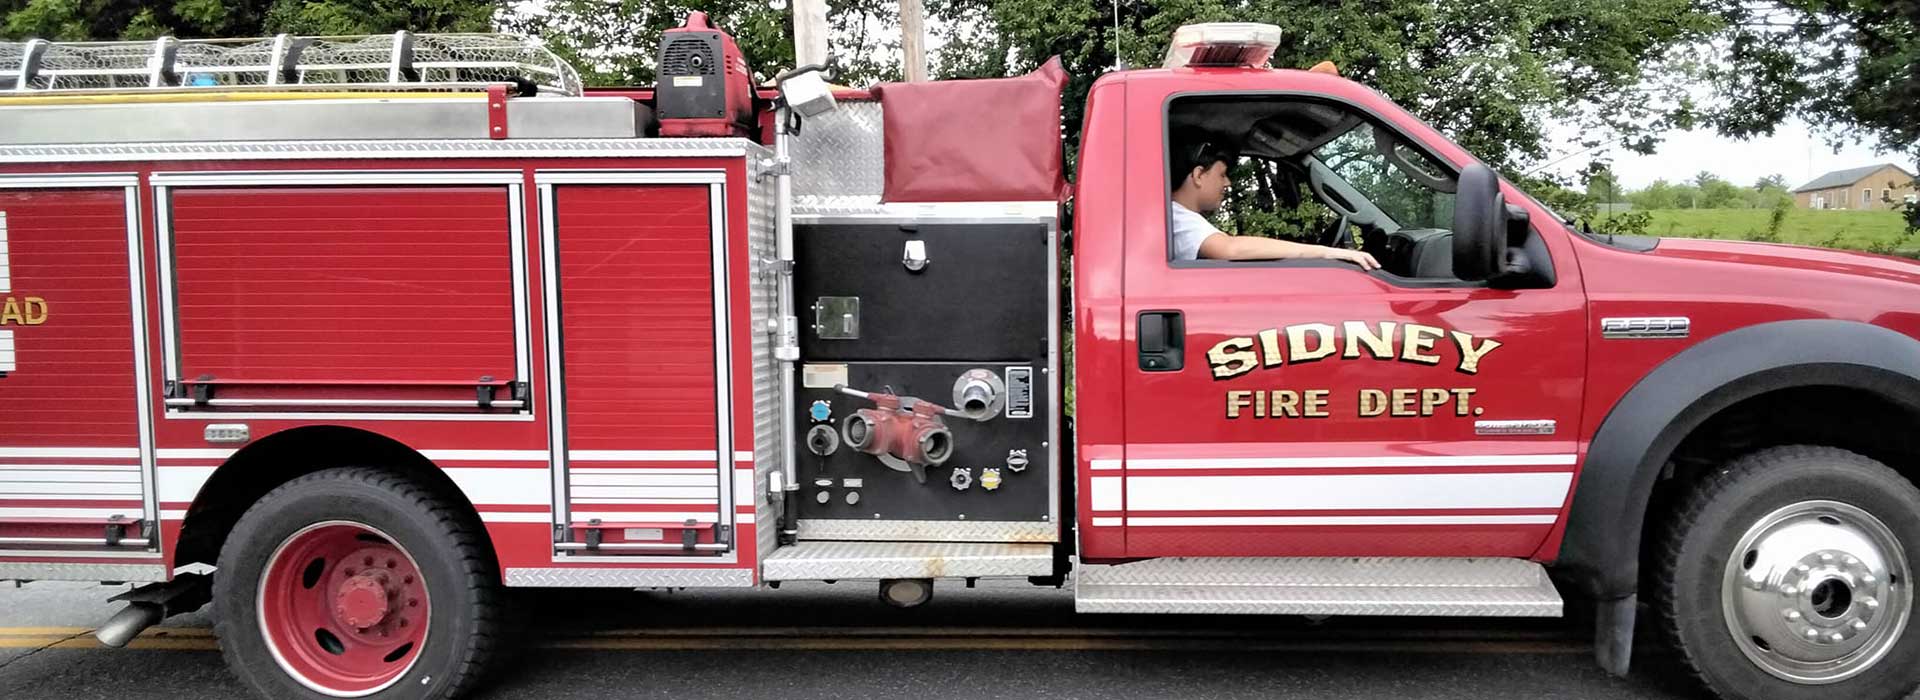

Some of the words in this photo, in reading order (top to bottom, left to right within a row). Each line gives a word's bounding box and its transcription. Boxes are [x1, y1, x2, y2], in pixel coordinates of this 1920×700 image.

[1206, 320, 1502, 380] SIDNEY
[1226, 389, 1331, 419] FIRE
[1358, 387, 1485, 418] DEPT.
